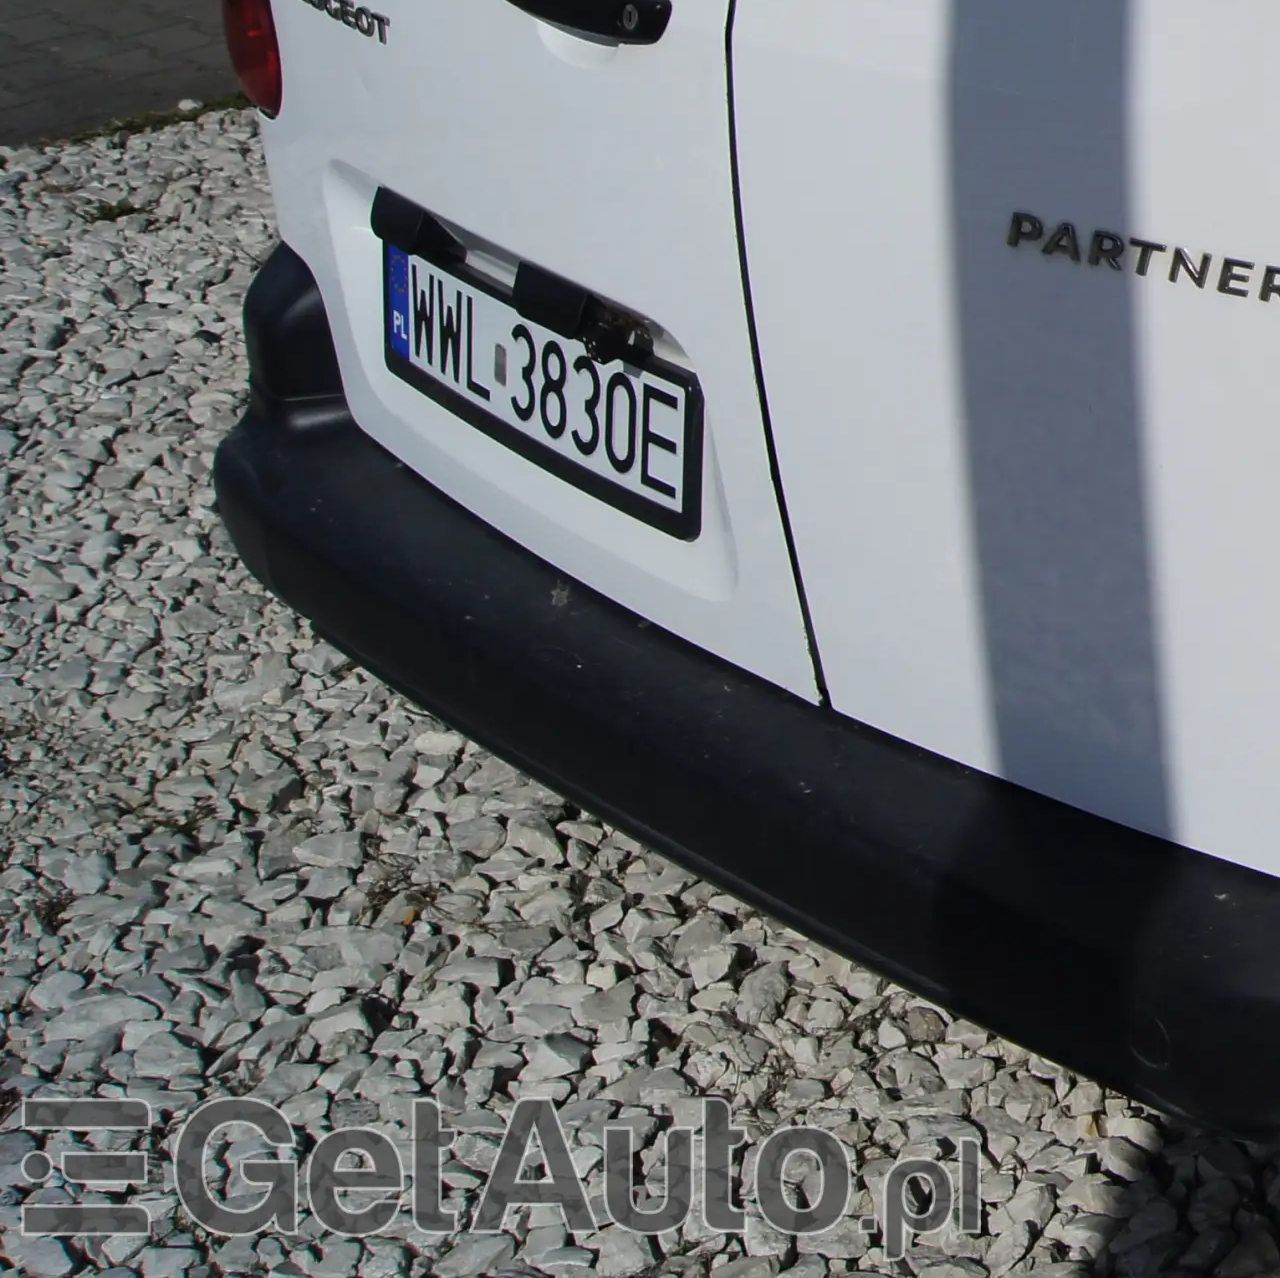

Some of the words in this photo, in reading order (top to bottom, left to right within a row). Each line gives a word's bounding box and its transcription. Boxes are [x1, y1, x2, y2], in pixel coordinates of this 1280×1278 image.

[392, 310, 409, 341] PL
[409, 262, 491, 402] WWL
[510, 323, 680, 500] 3830E
